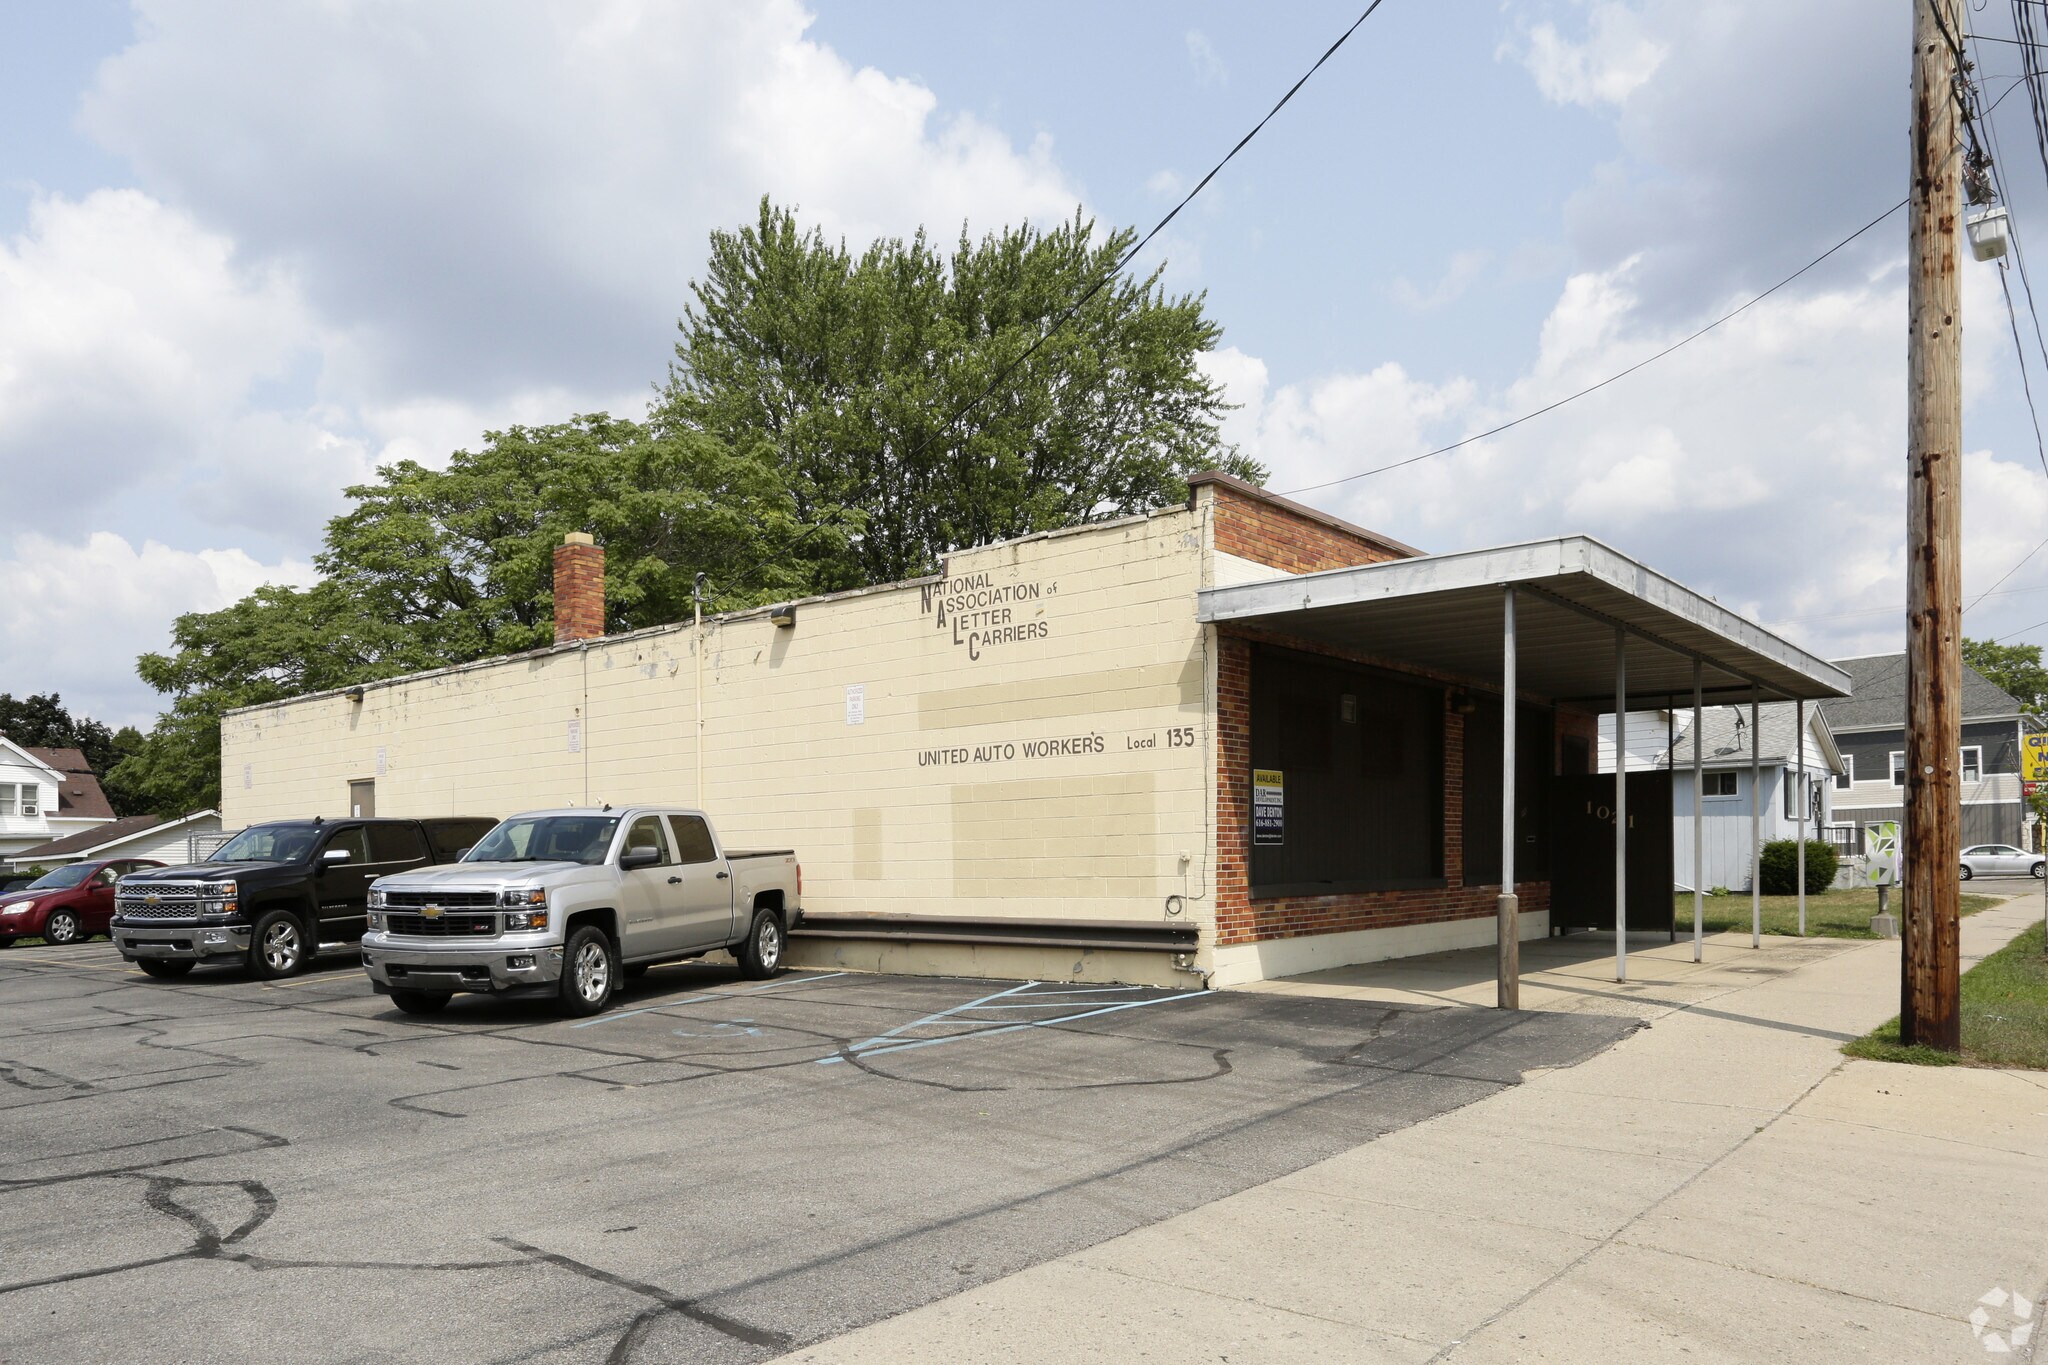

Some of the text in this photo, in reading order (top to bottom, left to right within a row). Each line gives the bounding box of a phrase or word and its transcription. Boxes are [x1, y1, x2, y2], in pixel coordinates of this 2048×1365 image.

[921, 573, 994, 615] NATIONAL
[936, 581, 1058, 629] ASSOCIATION of
[953, 608, 1012, 646] LETTER
[968, 621, 1049, 662] CARRIERS
[918, 748, 969, 767] UNITED
[973, 744, 1015, 762] AUTO
[1127, 733, 1156, 750] Local
[1167, 728, 1195, 748] 135
[1255, 788, 1266, 797] DAR
[1256, 774, 1281, 784] AVAILABLE
[1256, 807, 1266, 817] DAVE
